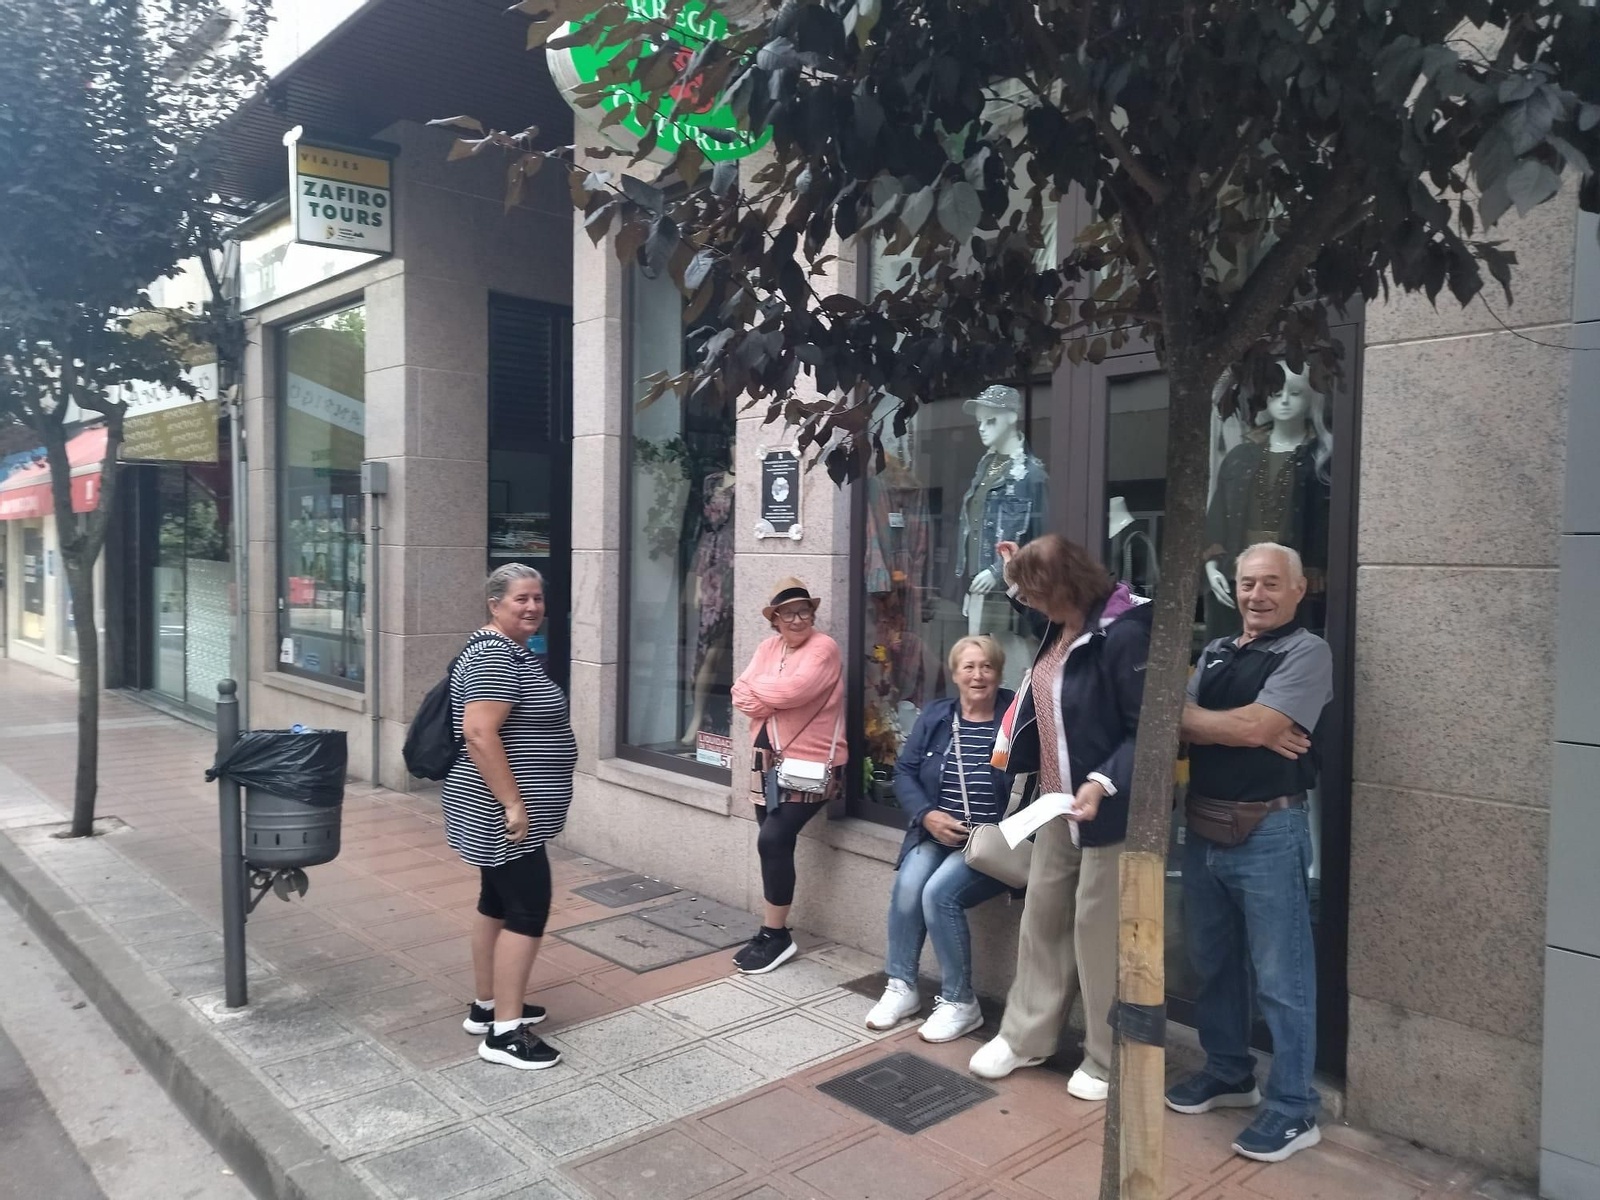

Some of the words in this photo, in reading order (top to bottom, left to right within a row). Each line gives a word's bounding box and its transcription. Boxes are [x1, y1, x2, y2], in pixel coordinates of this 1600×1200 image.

[301, 153, 359, 171] VIAJES
[303, 180, 387, 208] ZAFIRO
[308, 201, 383, 227] TOURS
